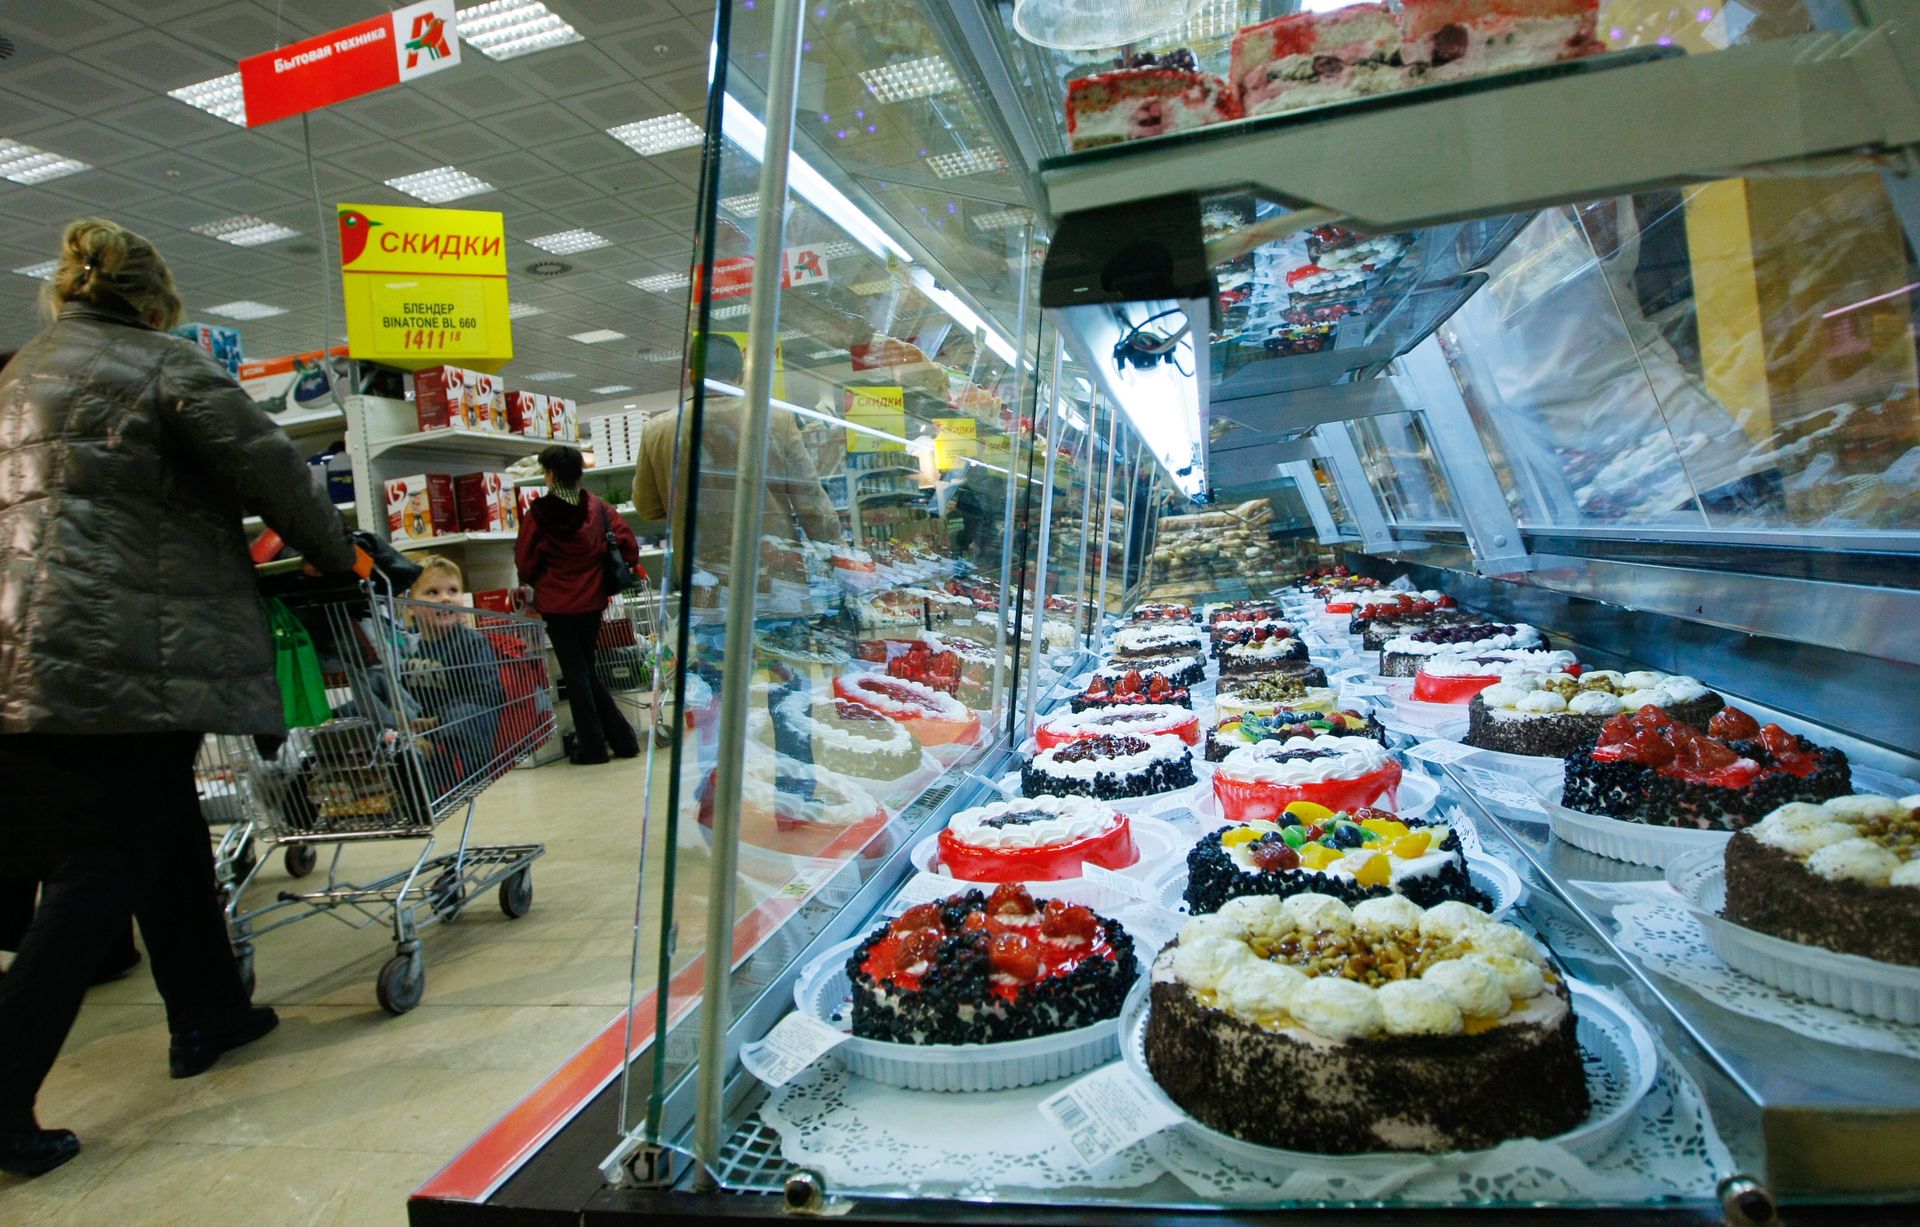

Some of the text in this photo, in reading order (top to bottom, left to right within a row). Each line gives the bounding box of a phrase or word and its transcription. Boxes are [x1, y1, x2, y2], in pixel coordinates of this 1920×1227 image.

[273, 26, 387, 74] Бытовая техника
[380, 231, 500, 260] СКИДКИ
[713, 261, 754, 274] Украшени
[403, 302, 455, 316] БЛЕНДЕР
[383, 316, 477, 329] BINATONE BL 660
[404, 329, 461, 350] 1411 18
[857, 396, 902, 410] СКИДКИ
